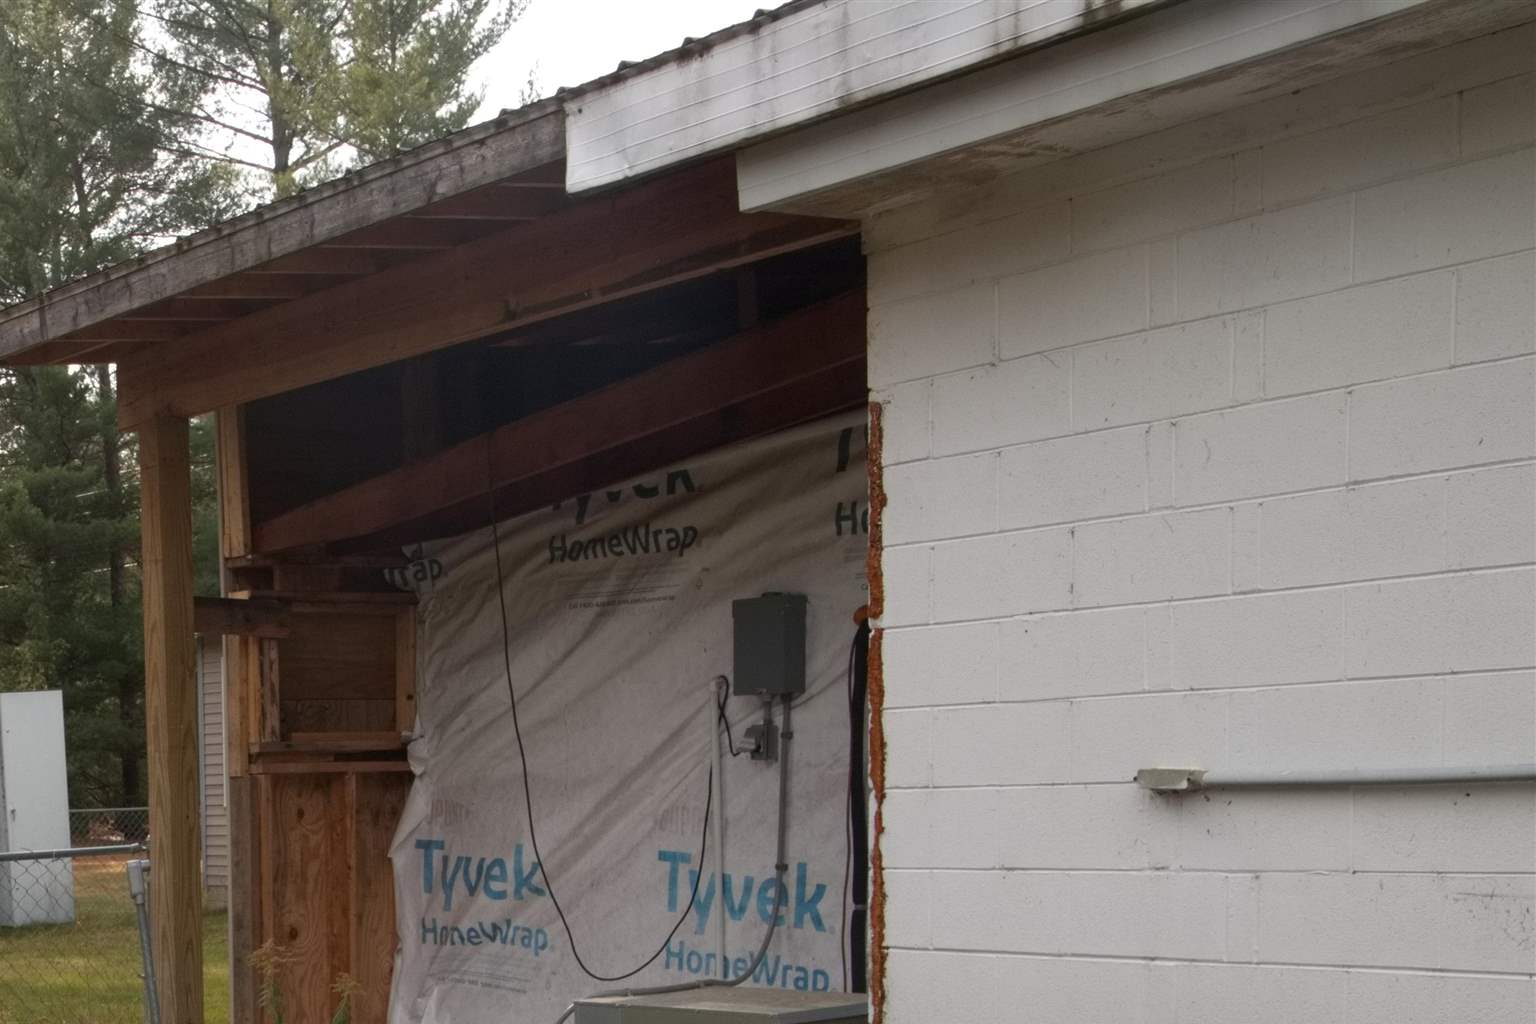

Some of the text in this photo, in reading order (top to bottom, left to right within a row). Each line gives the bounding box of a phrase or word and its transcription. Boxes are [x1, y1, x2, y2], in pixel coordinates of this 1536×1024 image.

[547, 521, 699, 563] HomeWrap
[415, 839, 547, 912] Tyvek
[658, 850, 827, 936] Tyvek
